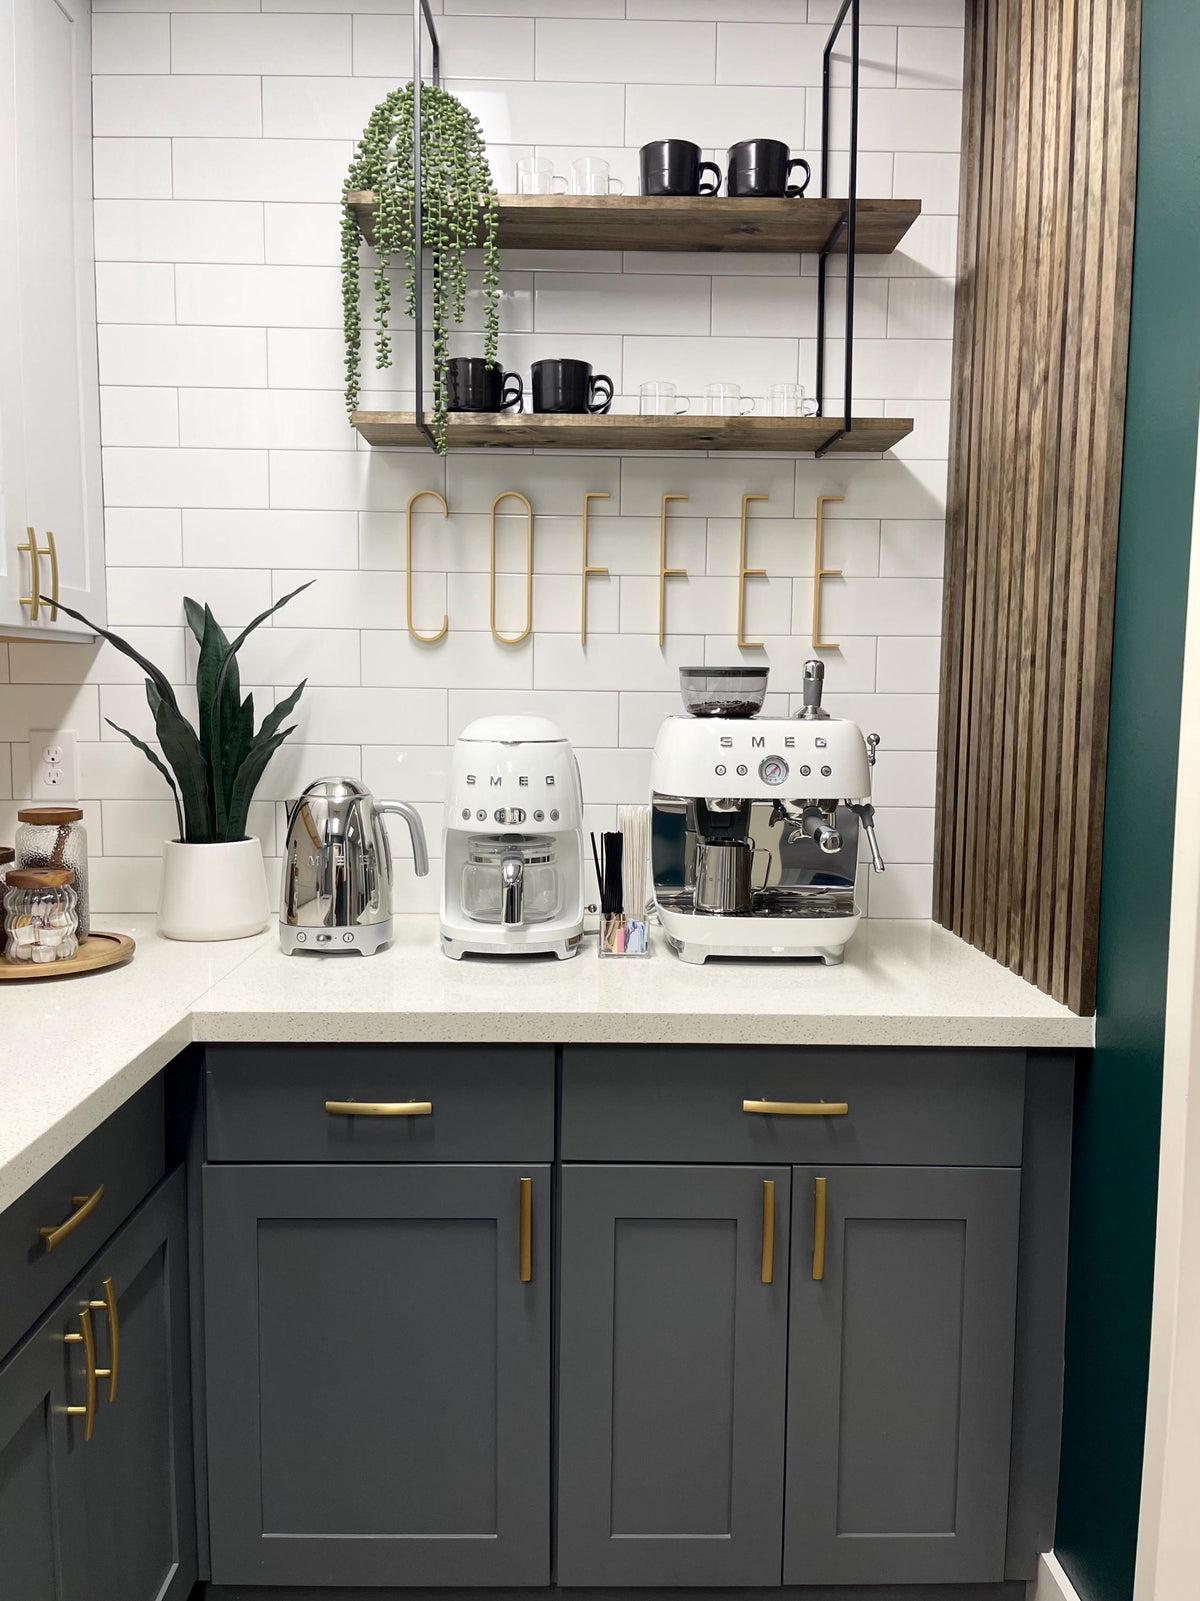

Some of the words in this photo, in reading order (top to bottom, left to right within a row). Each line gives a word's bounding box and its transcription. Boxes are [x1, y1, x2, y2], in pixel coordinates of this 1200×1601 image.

[406, 490, 845, 648] COFFEE
[720, 736, 827, 748] SMEG
[466, 774, 555, 787] SMEG
